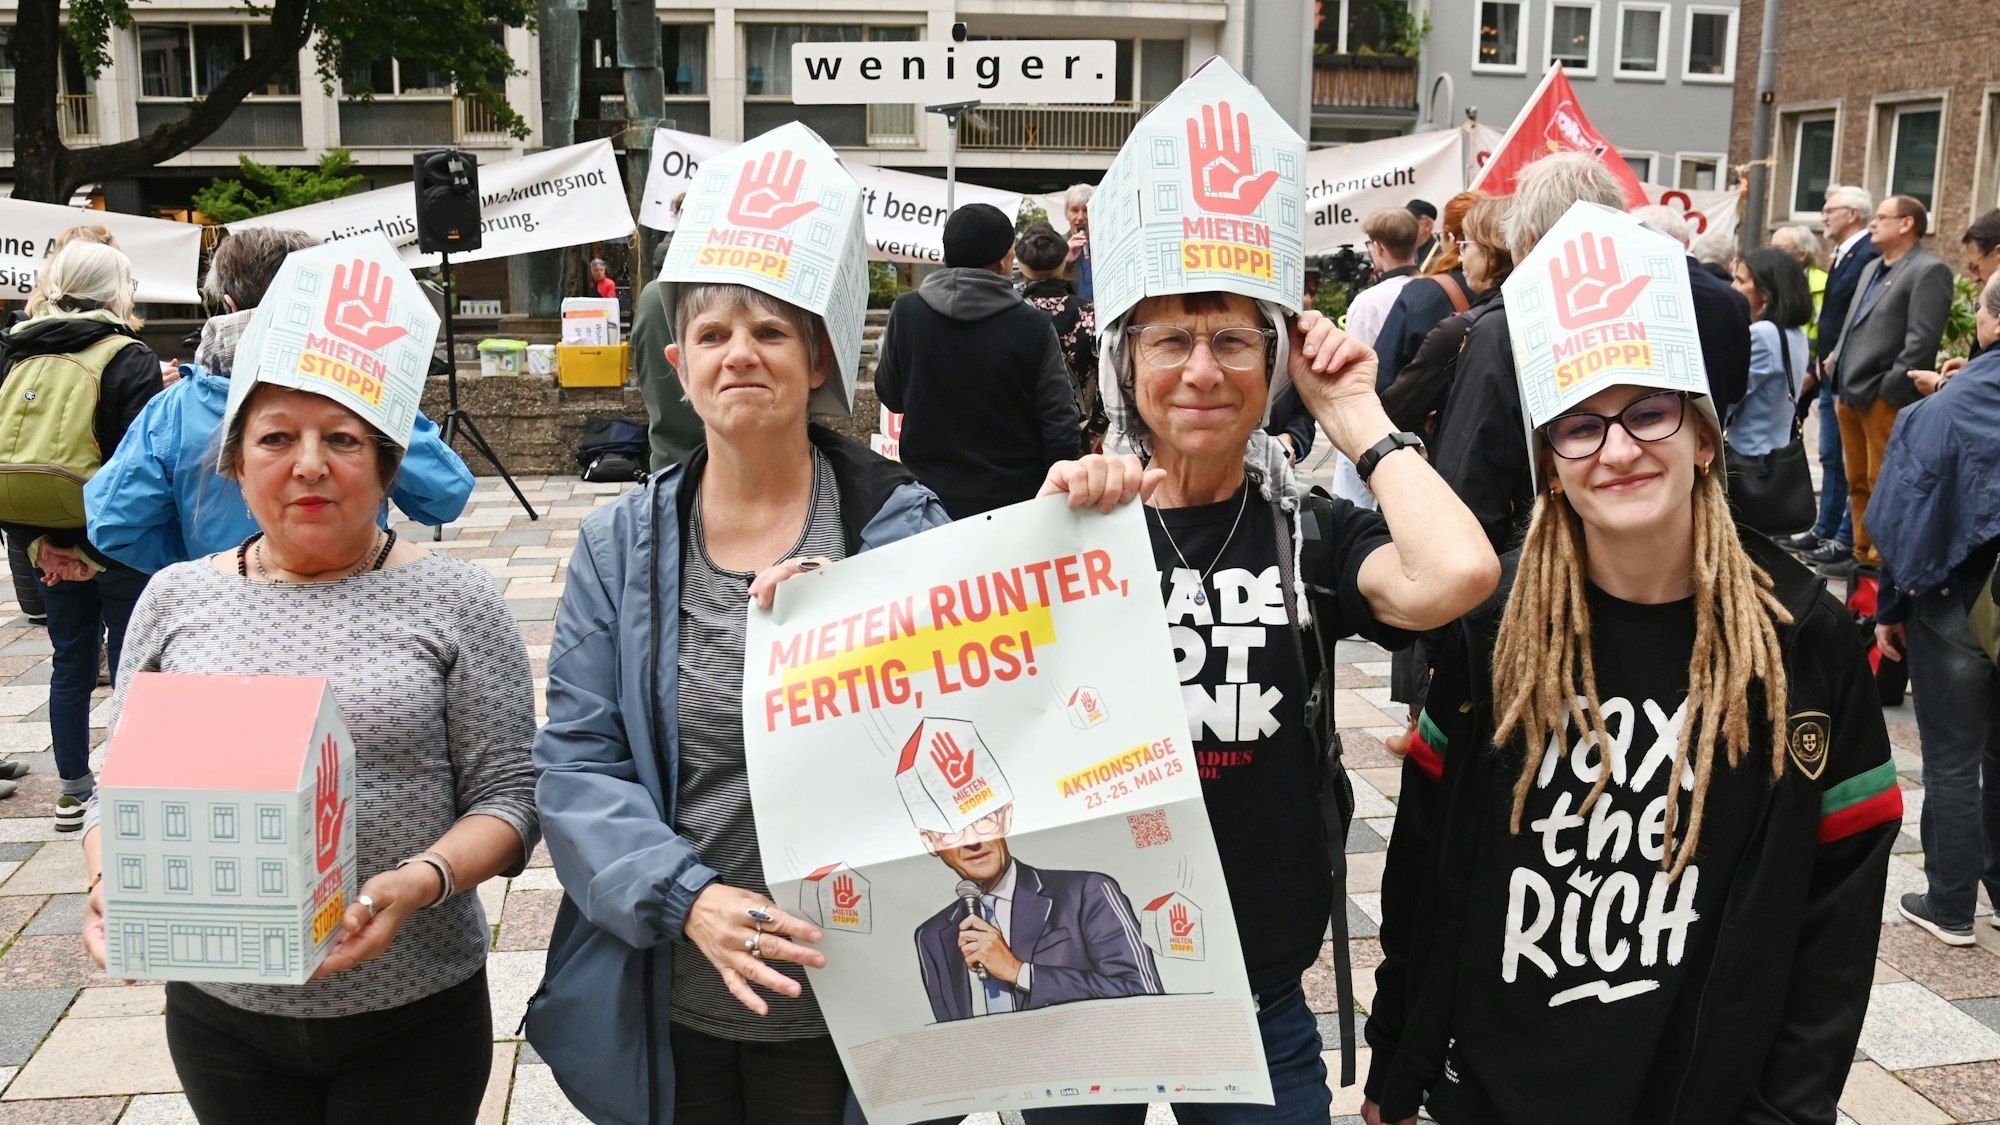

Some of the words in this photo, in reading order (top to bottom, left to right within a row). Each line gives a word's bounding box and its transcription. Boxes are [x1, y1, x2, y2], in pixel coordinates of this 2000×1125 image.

[805, 47, 1103, 89] weniger.
[481, 168, 607, 208] Wohnungsnot
[1183, 216, 1271, 249] MIETEN
[1314, 203, 1359, 226] alle.
[0, 237, 35, 258] ne
[699, 247, 787, 278] STOPP!
[707, 228, 793, 256] MIETEN
[876, 239, 945, 262] vertre
[1184, 244, 1272, 278] STOPP!
[305, 332, 388, 383] MIETEN
[1552, 321, 1647, 364] MIETEN
[301, 353, 382, 405] STOPP!
[1557, 344, 1651, 388] STOPP!
[768, 595, 916, 676] MIETEN
[929, 549, 1128, 631] RUNTER,
[765, 659, 923, 732] FERTIG,
[932, 630, 1038, 694] LOS!
[1062, 737, 1176, 798] AKTIONSTAGE
[1085, 781, 1133, 810] 23.-25.
[1134, 766, 1163, 790] MAI
[1164, 758, 1183, 777] 25
[952, 776, 987, 805] MIETEN
[959, 786, 994, 814] STOPP!
[1531, 791, 1680, 867] the
[313, 863, 343, 913] MIETEN
[314, 890, 344, 944] STOPP!
